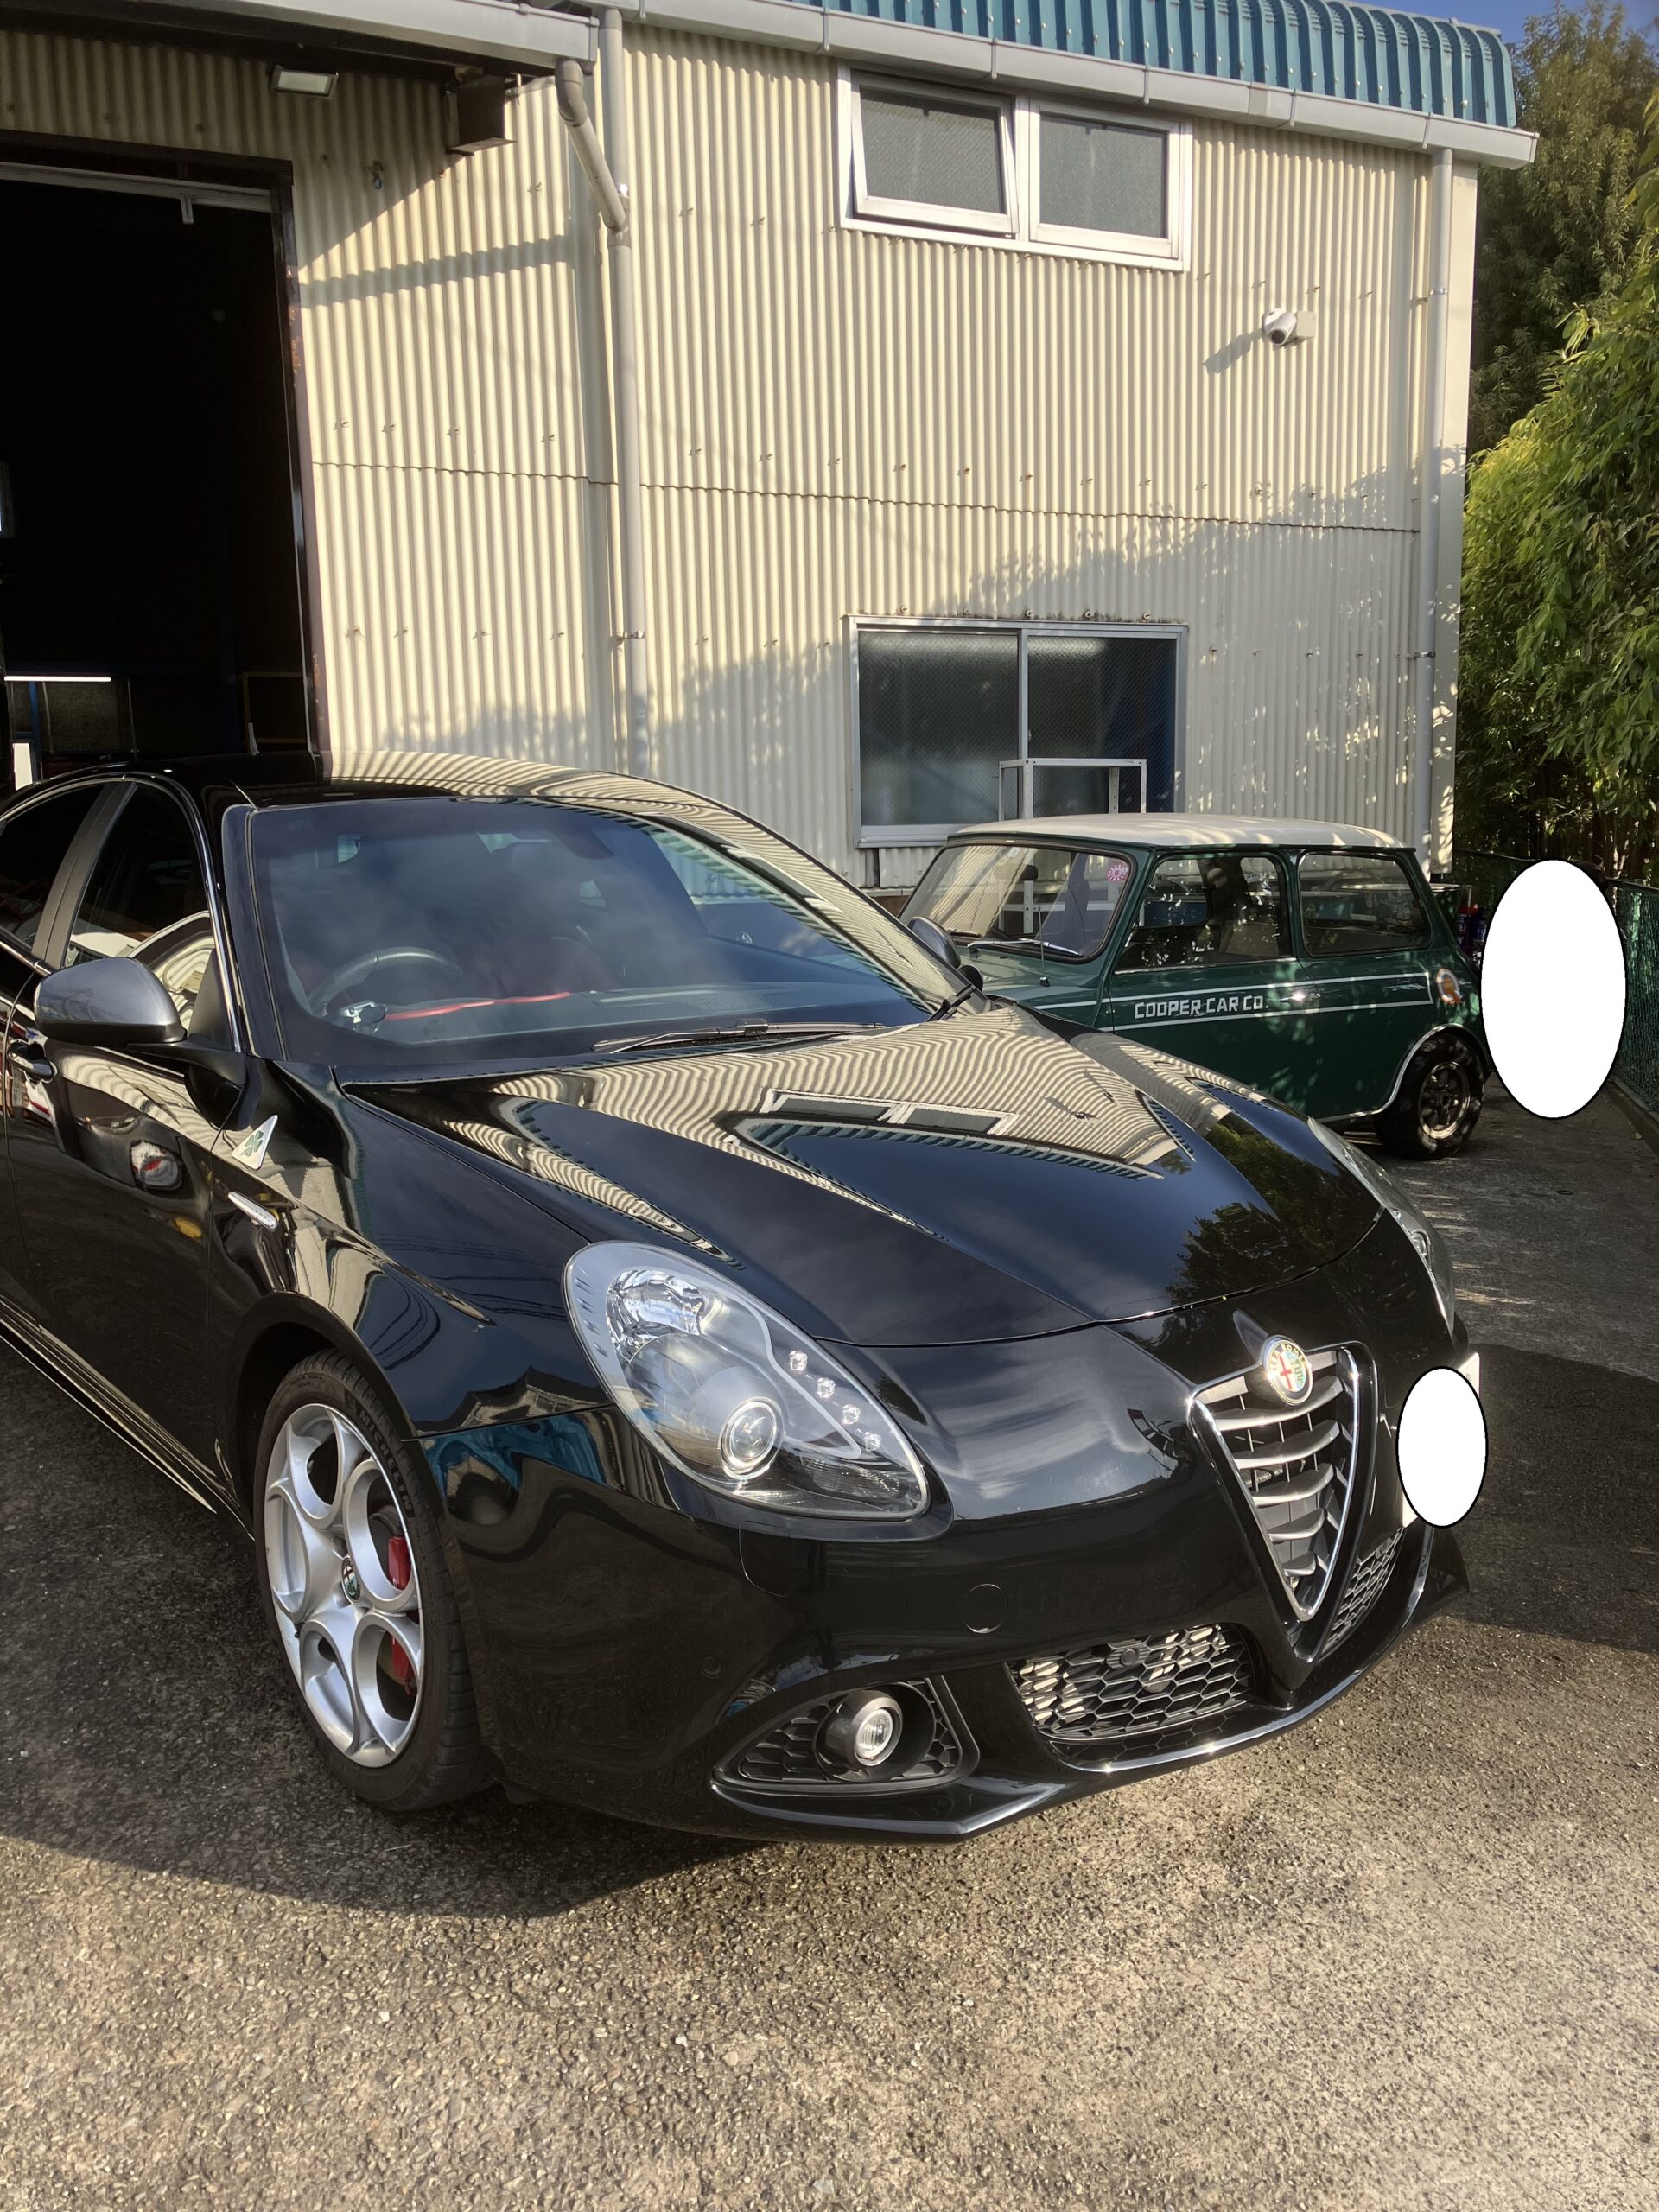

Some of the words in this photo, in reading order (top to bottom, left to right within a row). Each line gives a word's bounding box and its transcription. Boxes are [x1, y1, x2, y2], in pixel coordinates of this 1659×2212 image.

[1135, 999, 1201, 1020] COOPER
[1205, 996, 1239, 1014] CAR
[1243, 995, 1269, 1011] CO.
[359, 1411, 414, 1512] MICHELIN
